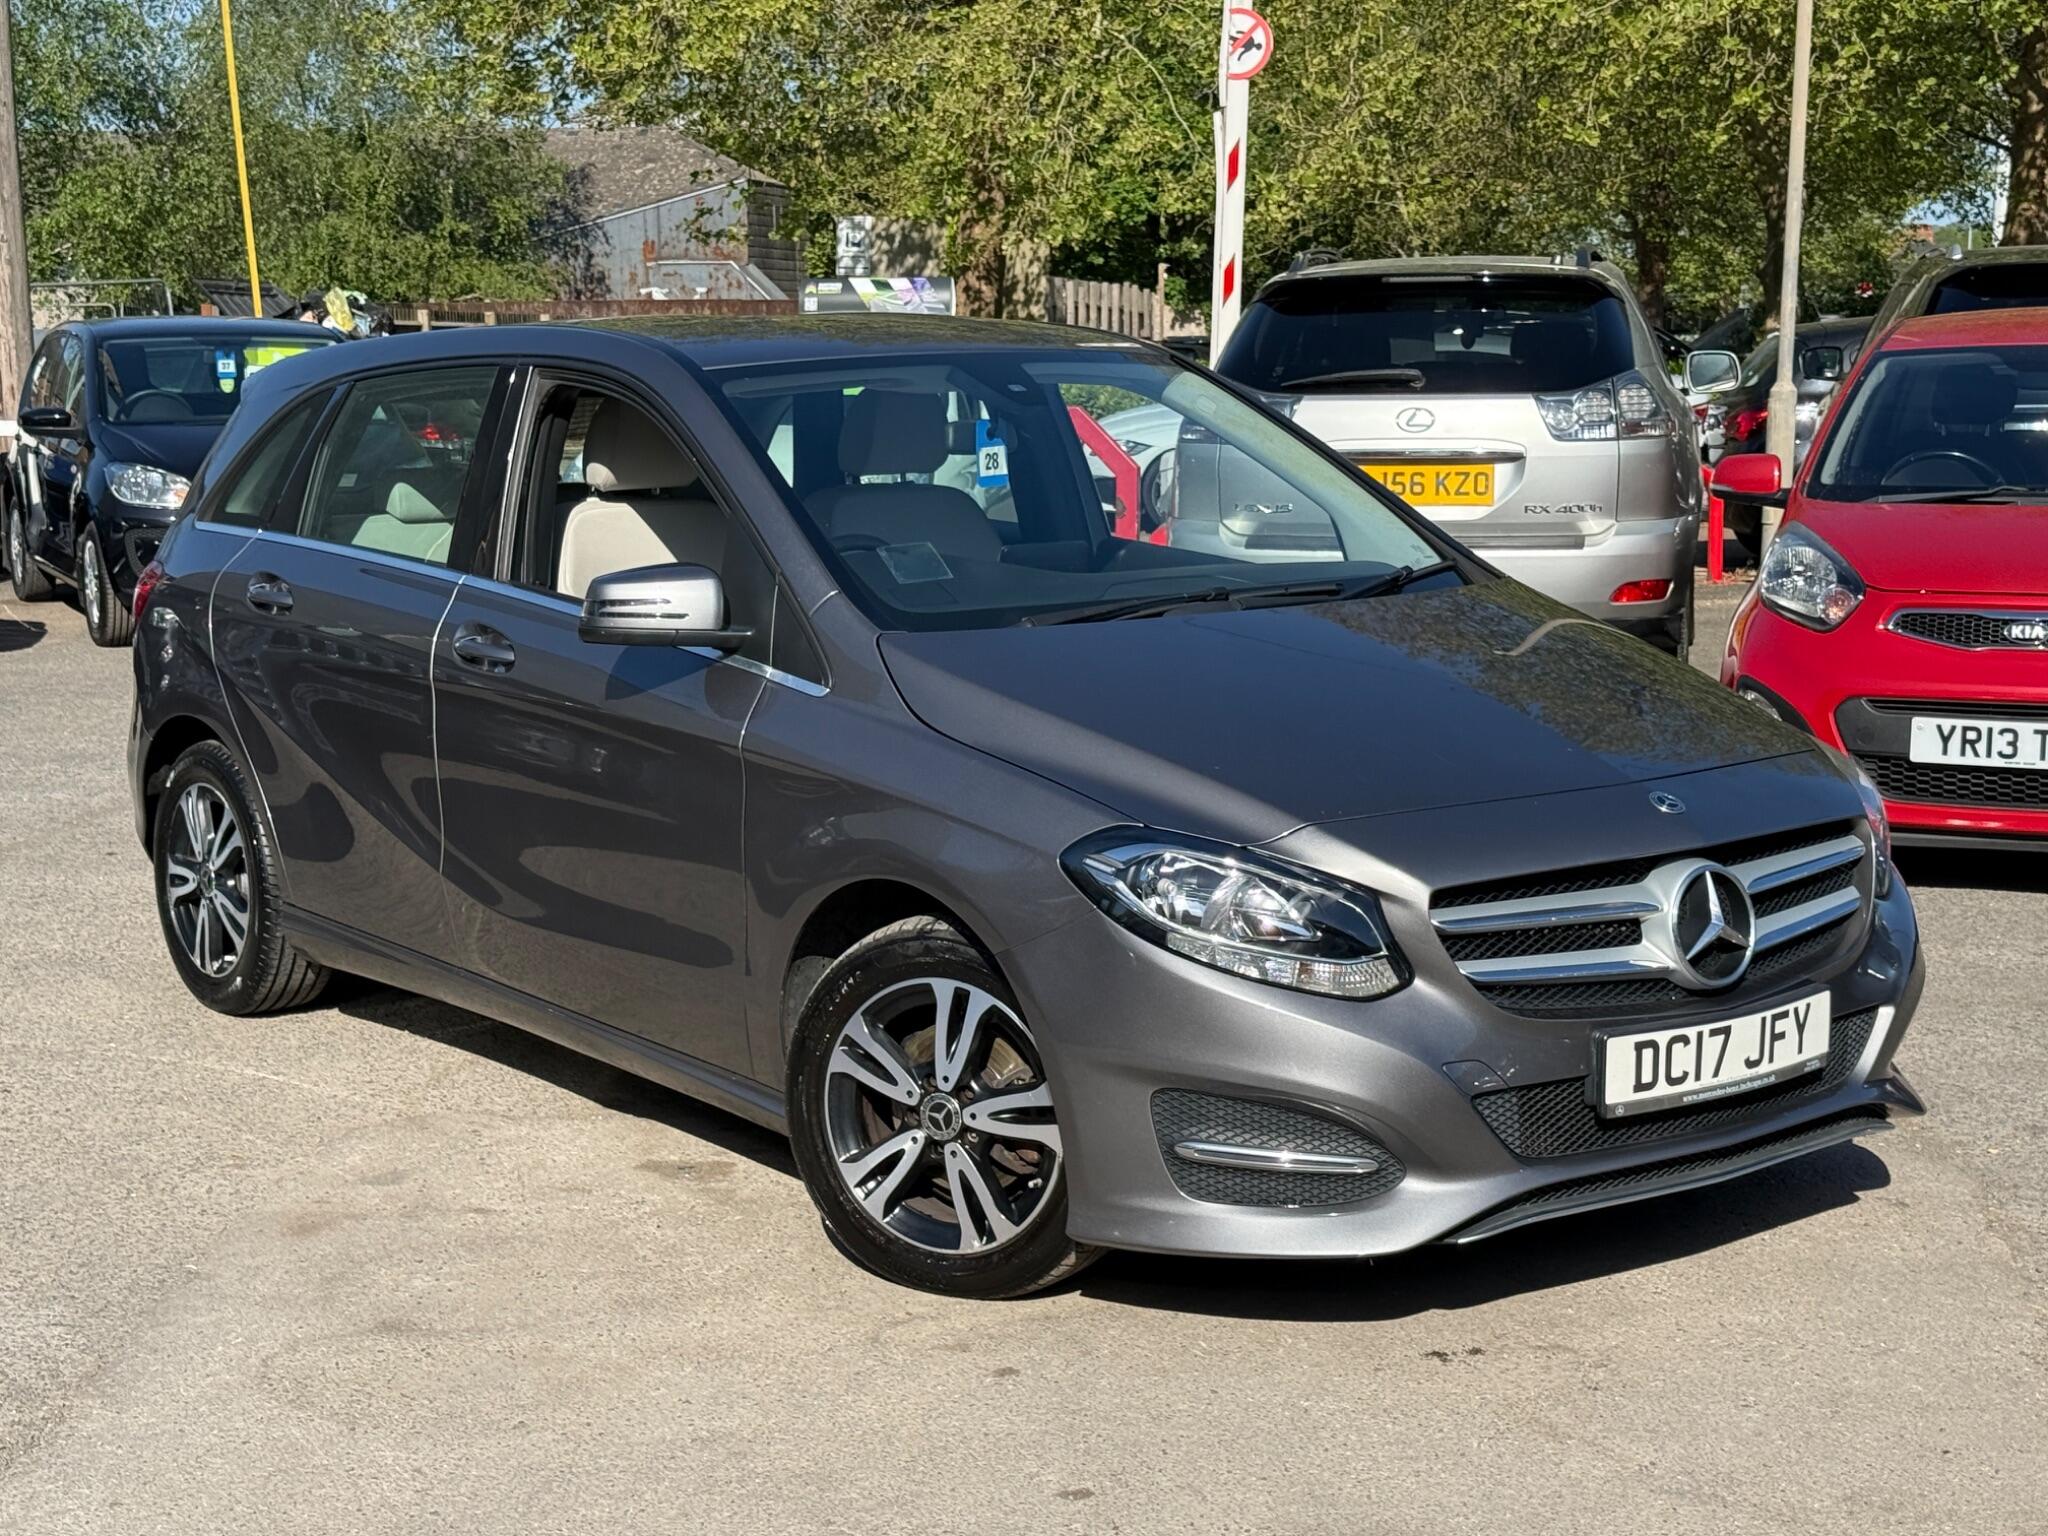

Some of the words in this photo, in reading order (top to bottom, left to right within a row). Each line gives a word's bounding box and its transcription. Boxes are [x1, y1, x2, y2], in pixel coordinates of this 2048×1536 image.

[985, 452, 999, 470] 28
[1524, 505, 1551, 514] RX
[1554, 504, 1602, 514] 400h
[2010, 624, 2045, 639] KIA
[1936, 724, 2019, 760] YR13
[1633, 1024, 1732, 1093] DC17
[1744, 1003, 1811, 1069] JFY
